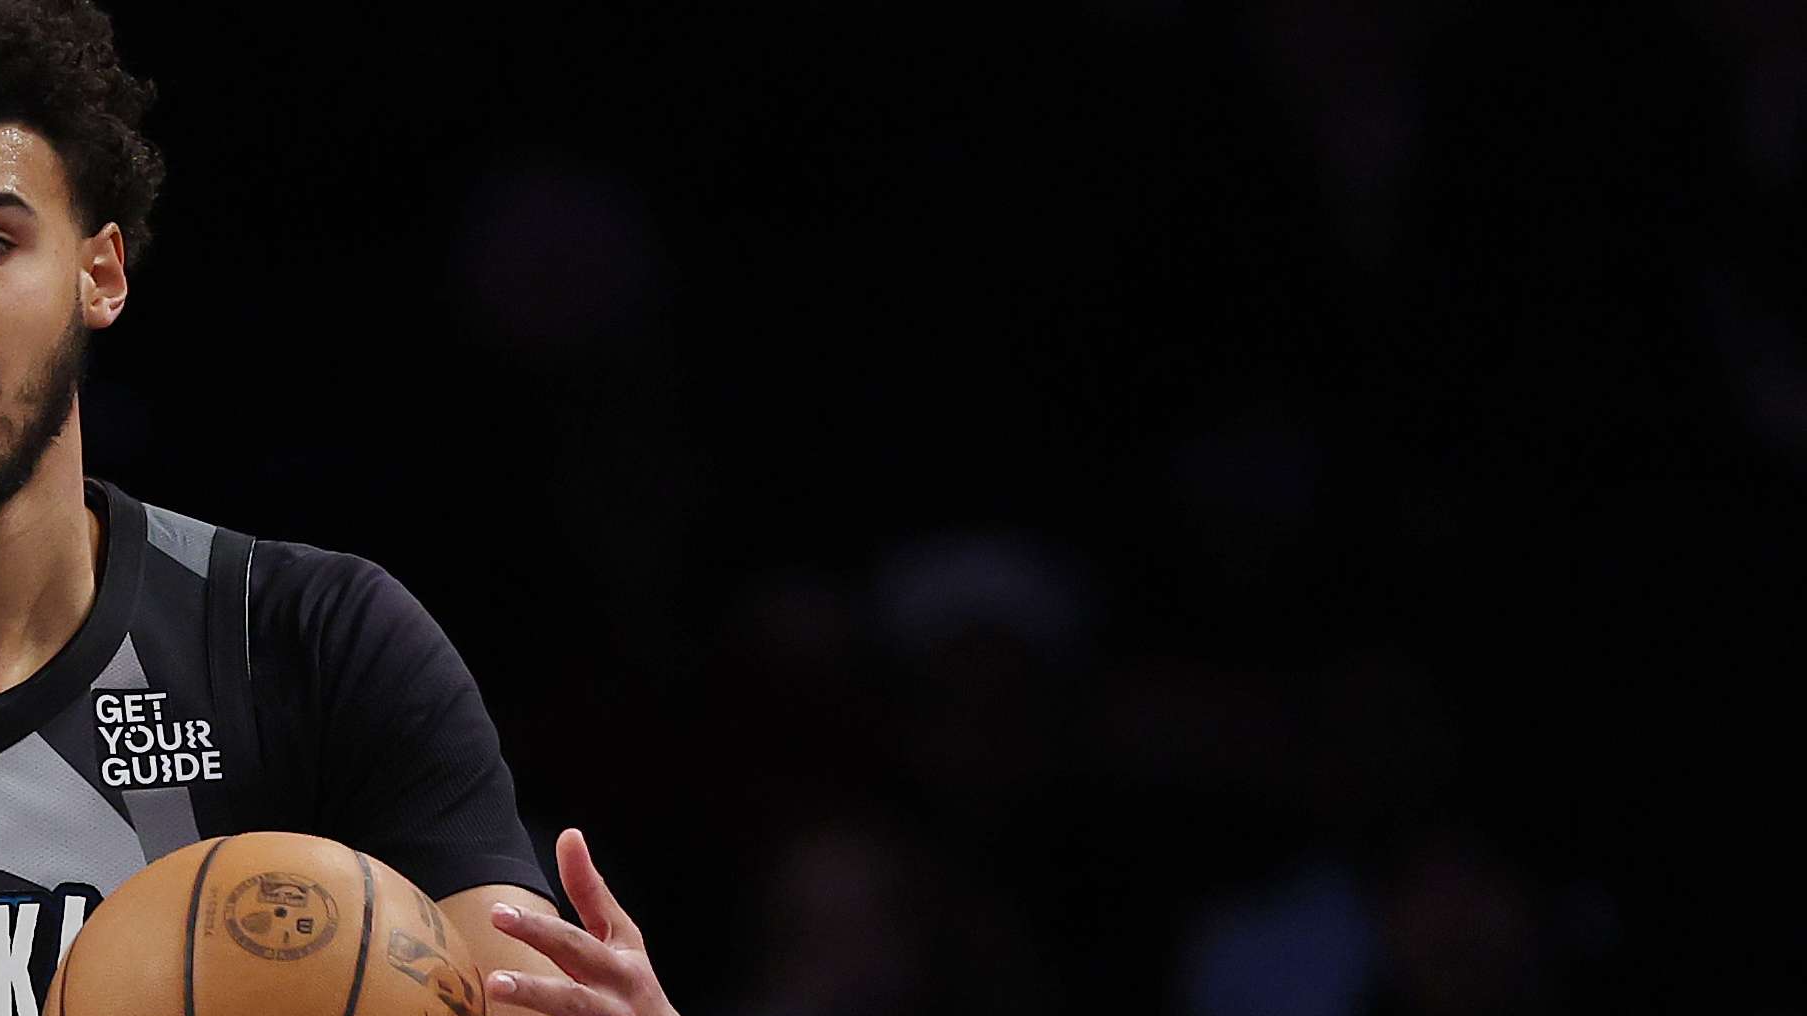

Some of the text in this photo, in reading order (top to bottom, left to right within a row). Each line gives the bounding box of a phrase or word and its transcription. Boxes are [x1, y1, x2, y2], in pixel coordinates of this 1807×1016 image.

[96, 692, 167, 724] GET
[98, 720, 214, 755] YOUR
[102, 750, 223, 787] GUIDE
